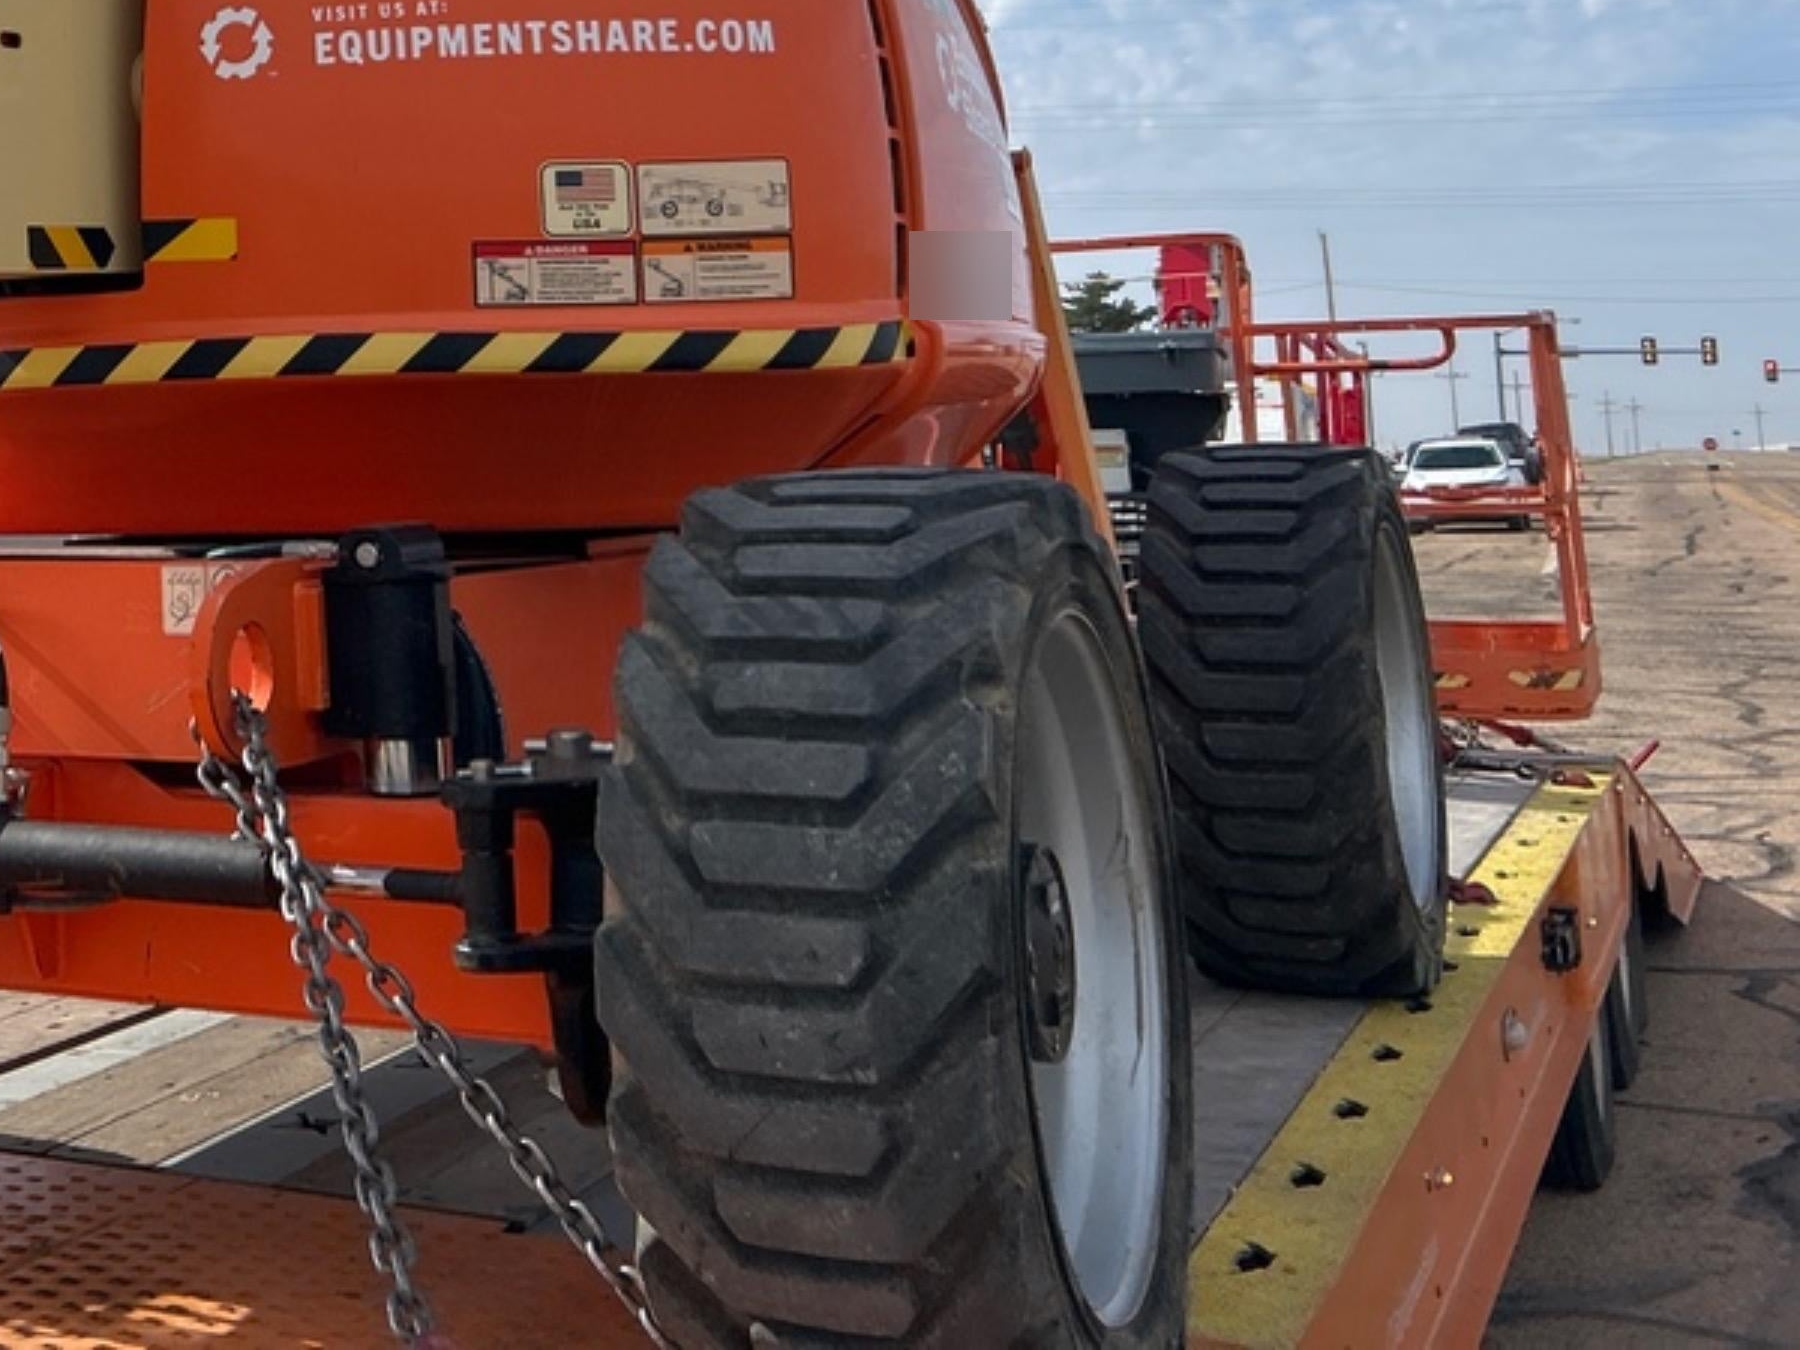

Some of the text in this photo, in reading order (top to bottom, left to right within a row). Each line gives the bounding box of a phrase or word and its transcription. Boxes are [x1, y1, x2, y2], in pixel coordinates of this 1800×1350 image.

[312, 0, 448, 22] VISIT US AT:
[313, 18, 776, 66] EQUIPMENTSHARE.COM
